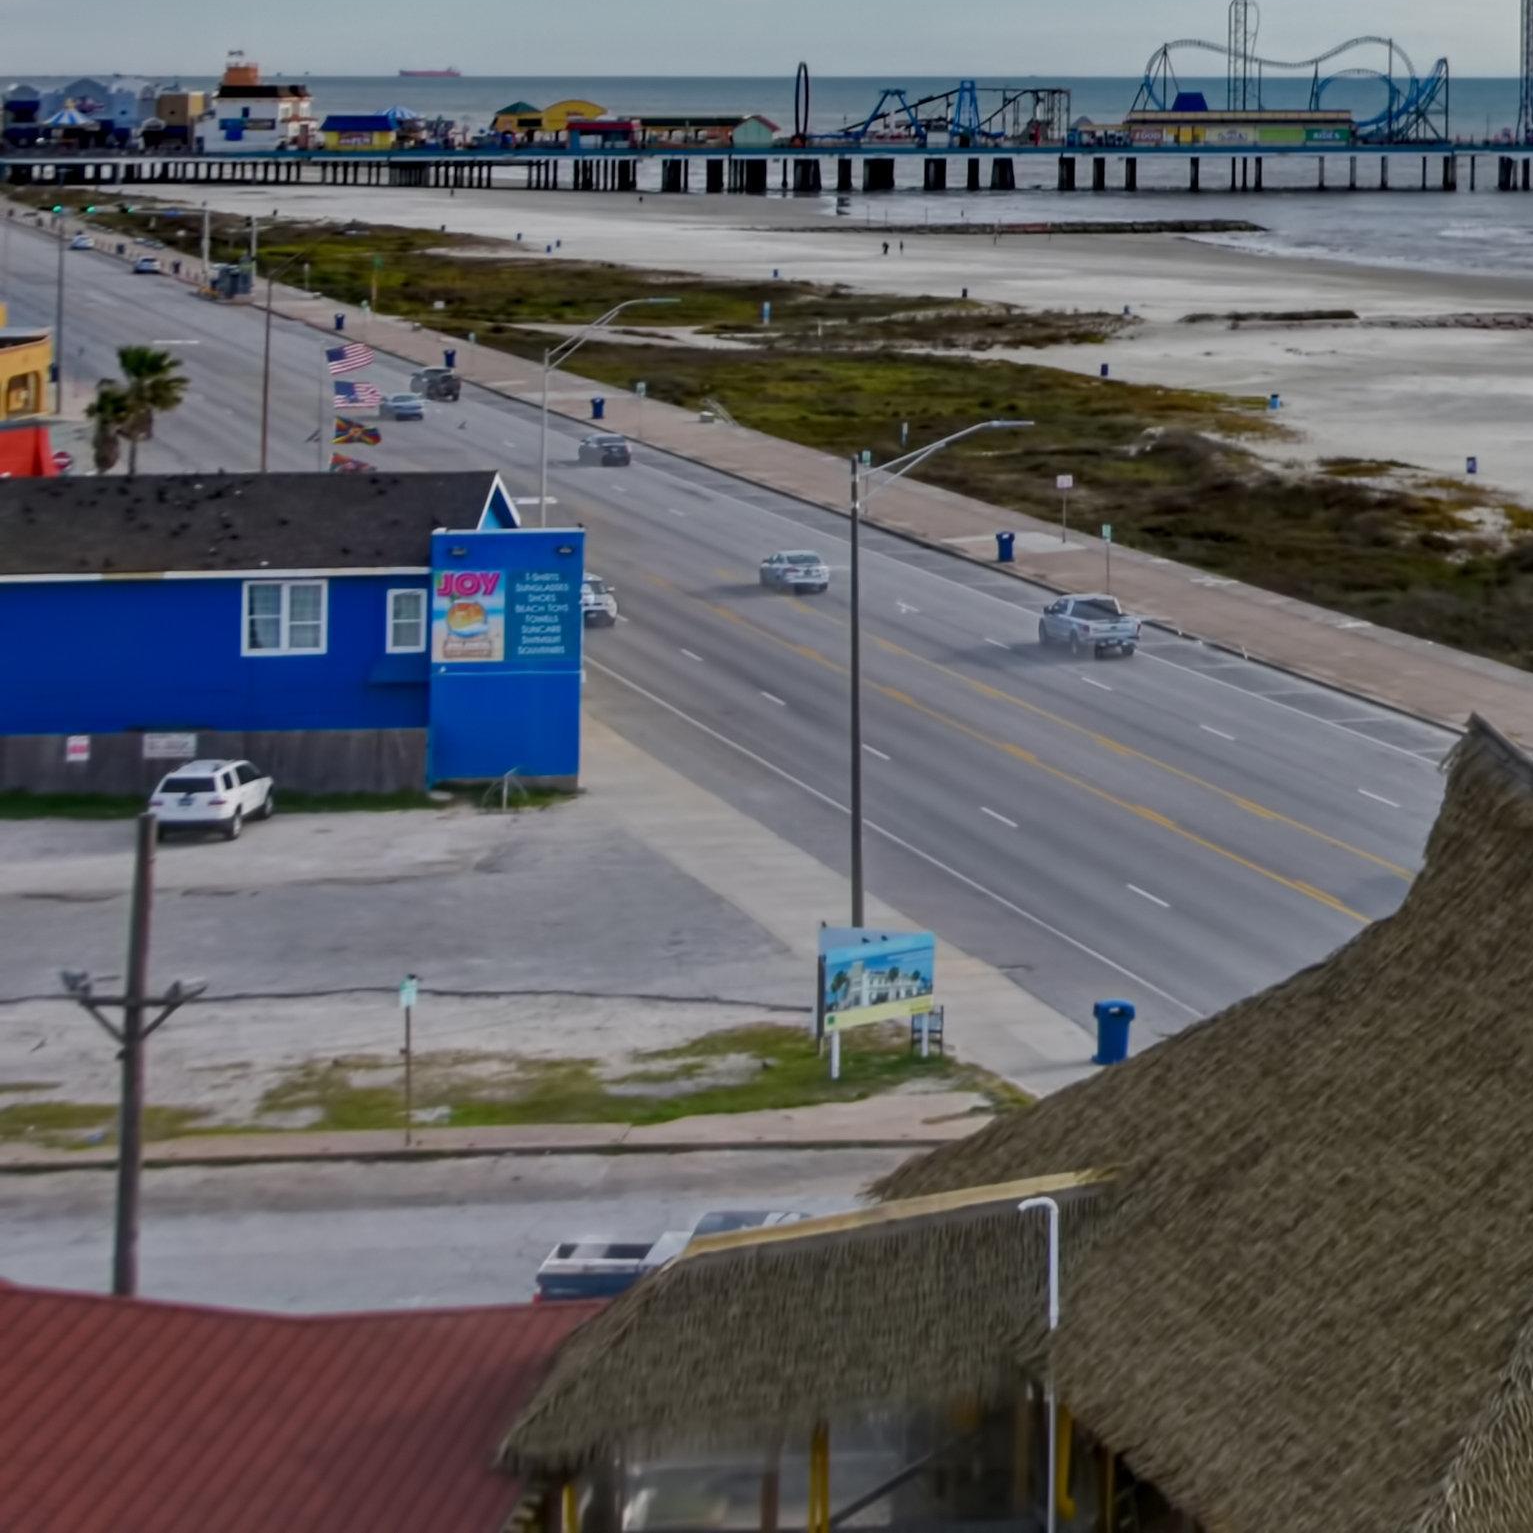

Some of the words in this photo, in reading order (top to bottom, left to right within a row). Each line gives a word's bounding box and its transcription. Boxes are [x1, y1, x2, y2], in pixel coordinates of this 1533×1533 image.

[436, 571, 501, 597] JOY
[515, 583, 569, 592] SUNGLASSES
[528, 594, 557, 603] SHOES
[515, 604, 546, 613] BEACH
[547, 603, 569, 613] TOYS
